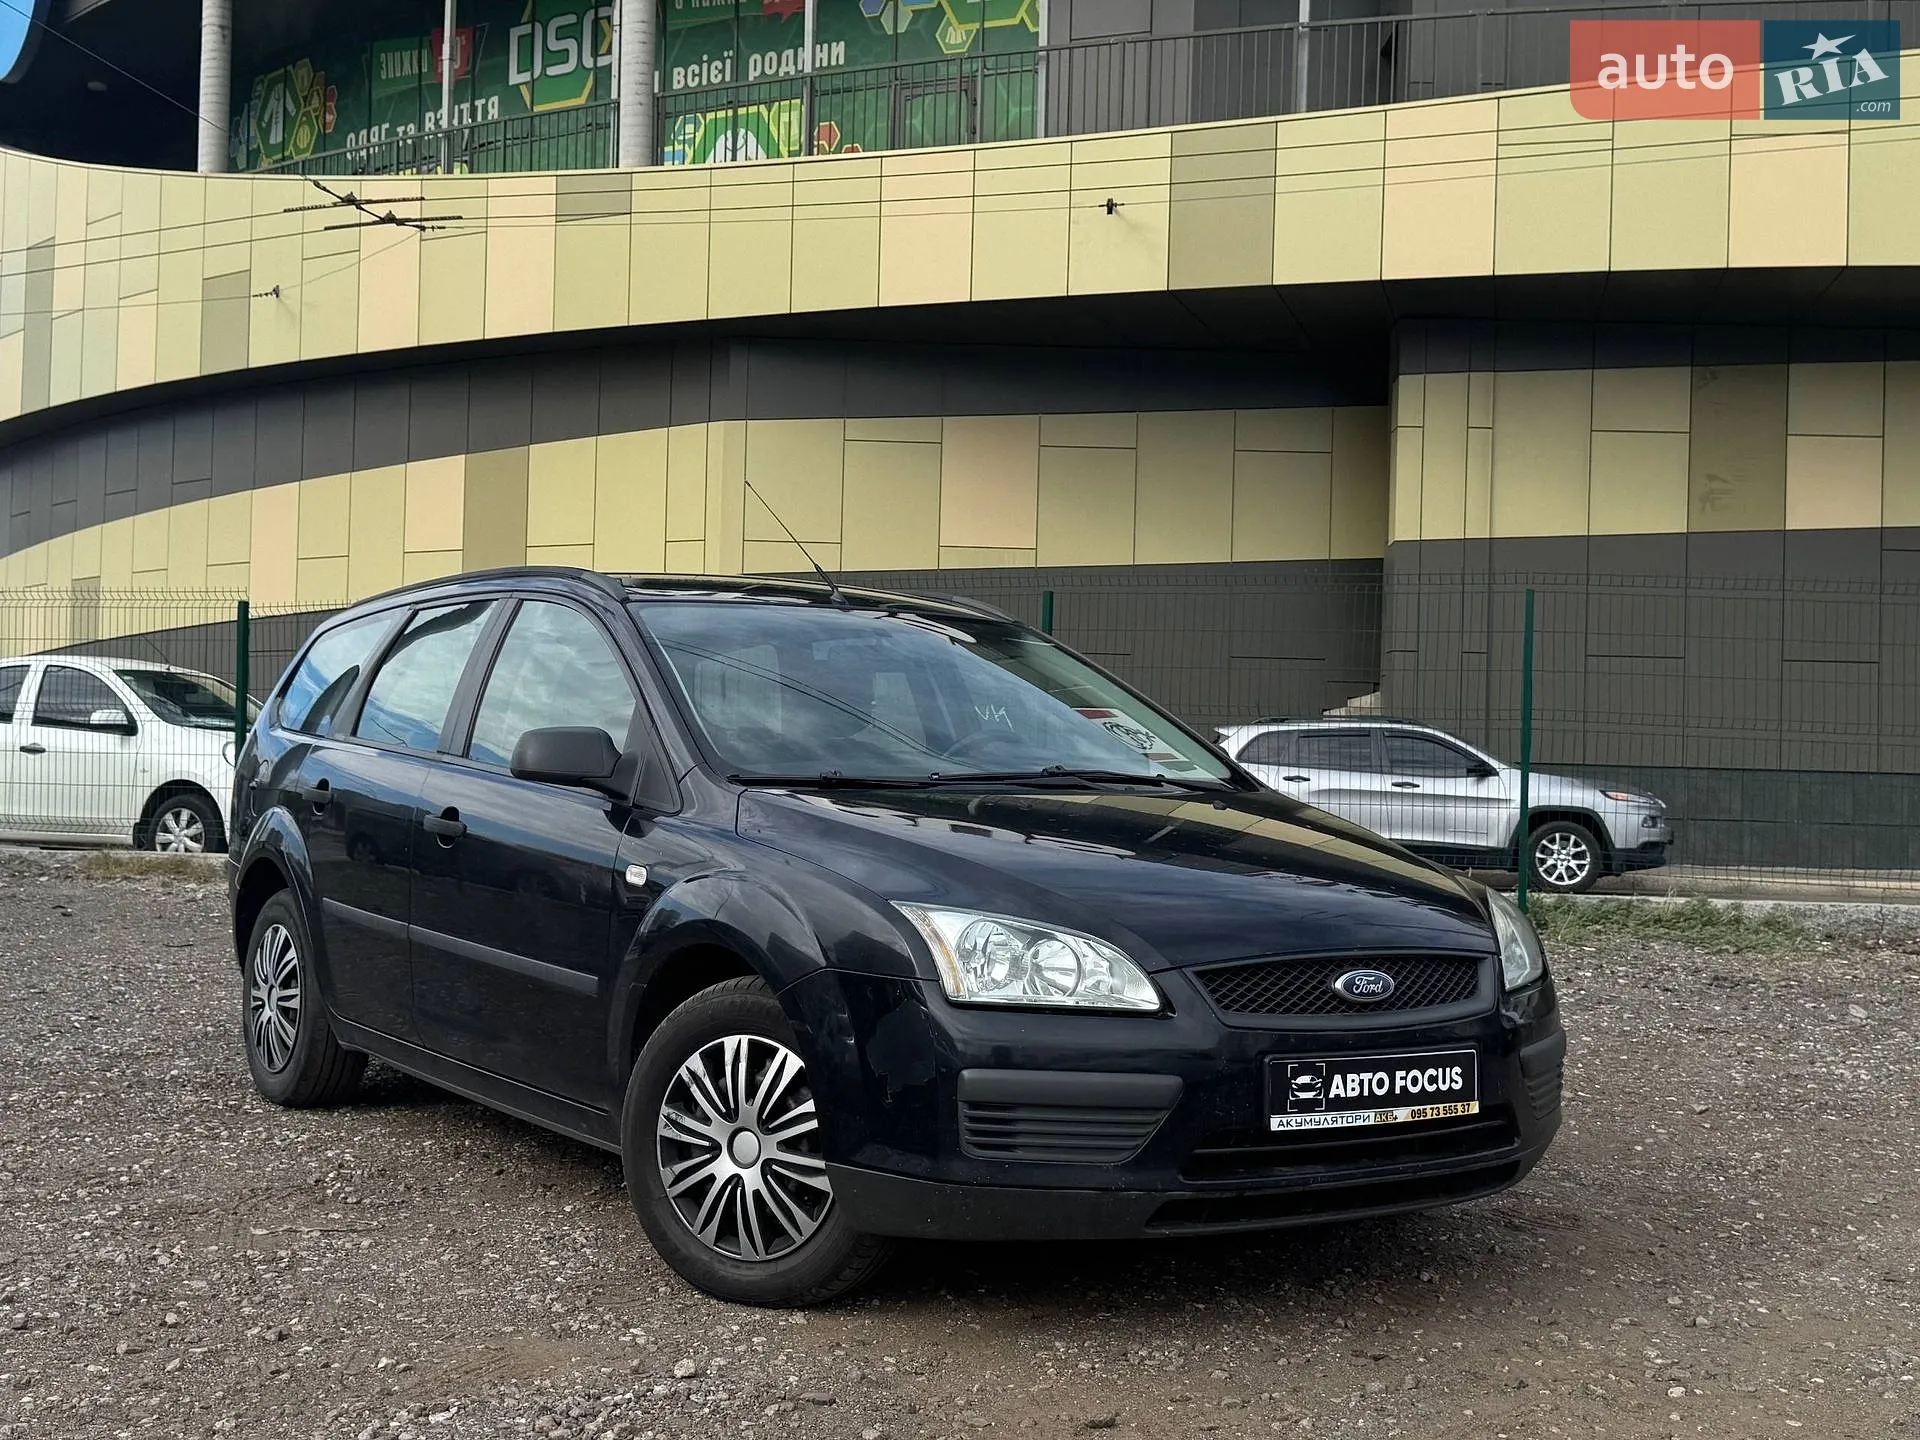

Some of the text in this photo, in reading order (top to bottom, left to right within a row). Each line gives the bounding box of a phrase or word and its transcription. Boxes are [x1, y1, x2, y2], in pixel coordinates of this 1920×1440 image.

[672, 50, 734, 90] всієї
[1353, 976, 1383, 993] Ford
[1329, 1066, 1463, 1099] АВТО FOCUS
[1277, 1114, 1370, 1129] АКУМУЛЯТОРИ
[1410, 1108, 1428, 1120] 095
[1430, 1106, 1441, 1117] 73
[1442, 1104, 1459, 1116] 555
[1460, 1103, 1471, 1114] 37
